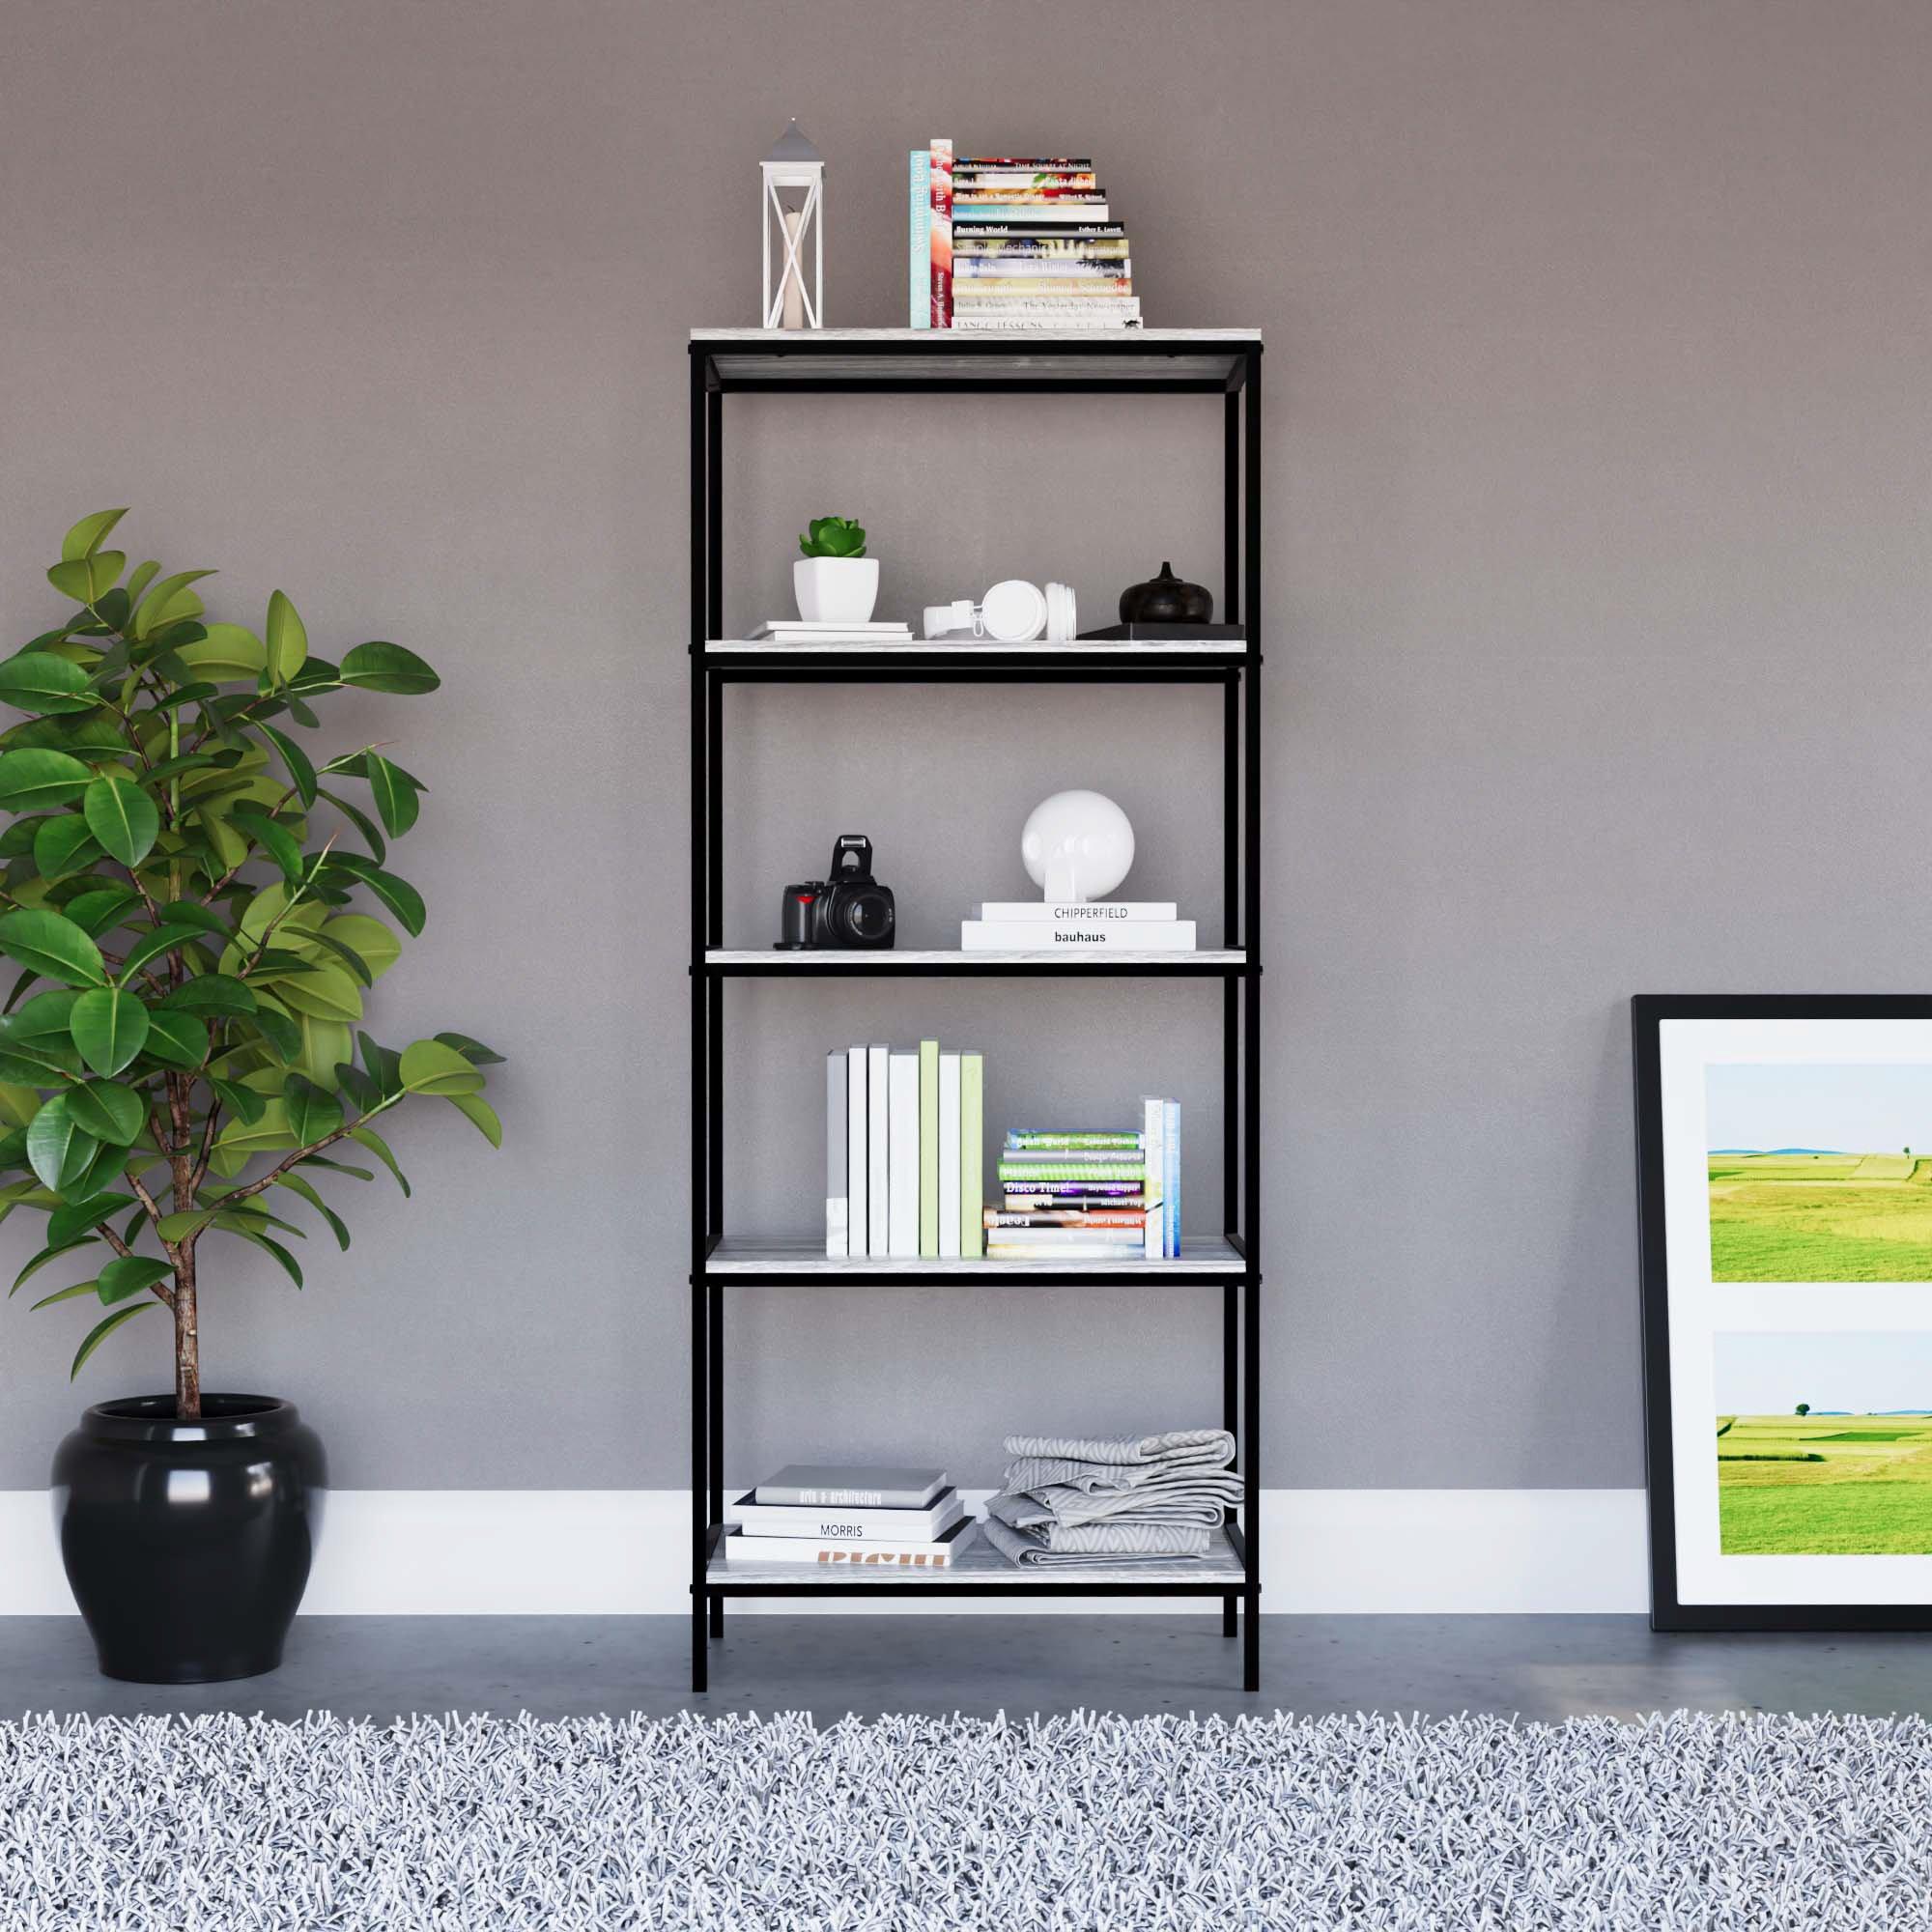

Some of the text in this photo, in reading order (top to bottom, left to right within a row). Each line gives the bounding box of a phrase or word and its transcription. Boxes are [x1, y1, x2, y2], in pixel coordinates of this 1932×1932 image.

[956, 225, 984, 235] Burning
[1054, 907, 1128, 919] CHIPPERFIELD
[1054, 931, 1106, 943] bauhaus
[1006, 1181, 1036, 1193] Disco
[820, 1524, 864, 1538] MORRIS
